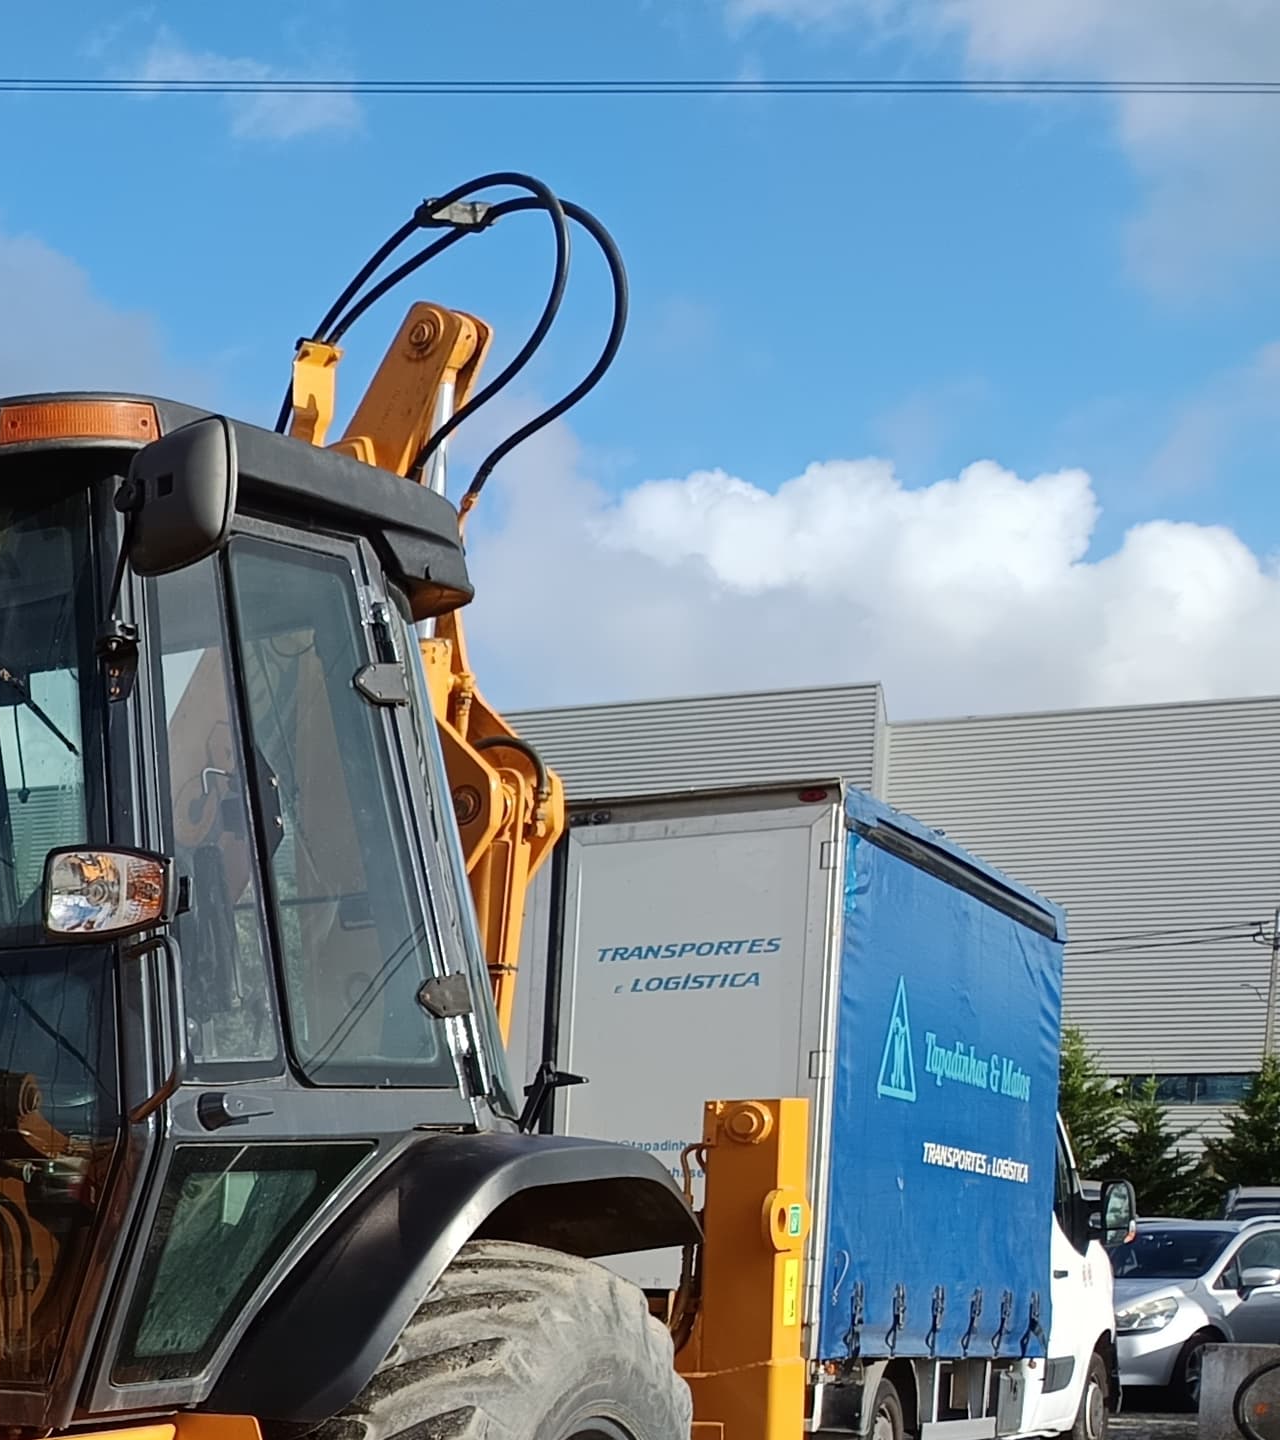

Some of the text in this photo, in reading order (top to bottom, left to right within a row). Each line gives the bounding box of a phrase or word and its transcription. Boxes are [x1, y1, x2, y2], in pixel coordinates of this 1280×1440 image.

[597, 937, 782, 963] TRANSPORTES
[630, 972, 760, 993] LOGÍSTICA
[925, 1031, 1031, 1102] Tapadinhas & Matos
[922, 1141, 987, 1175] TRANSPORTES
